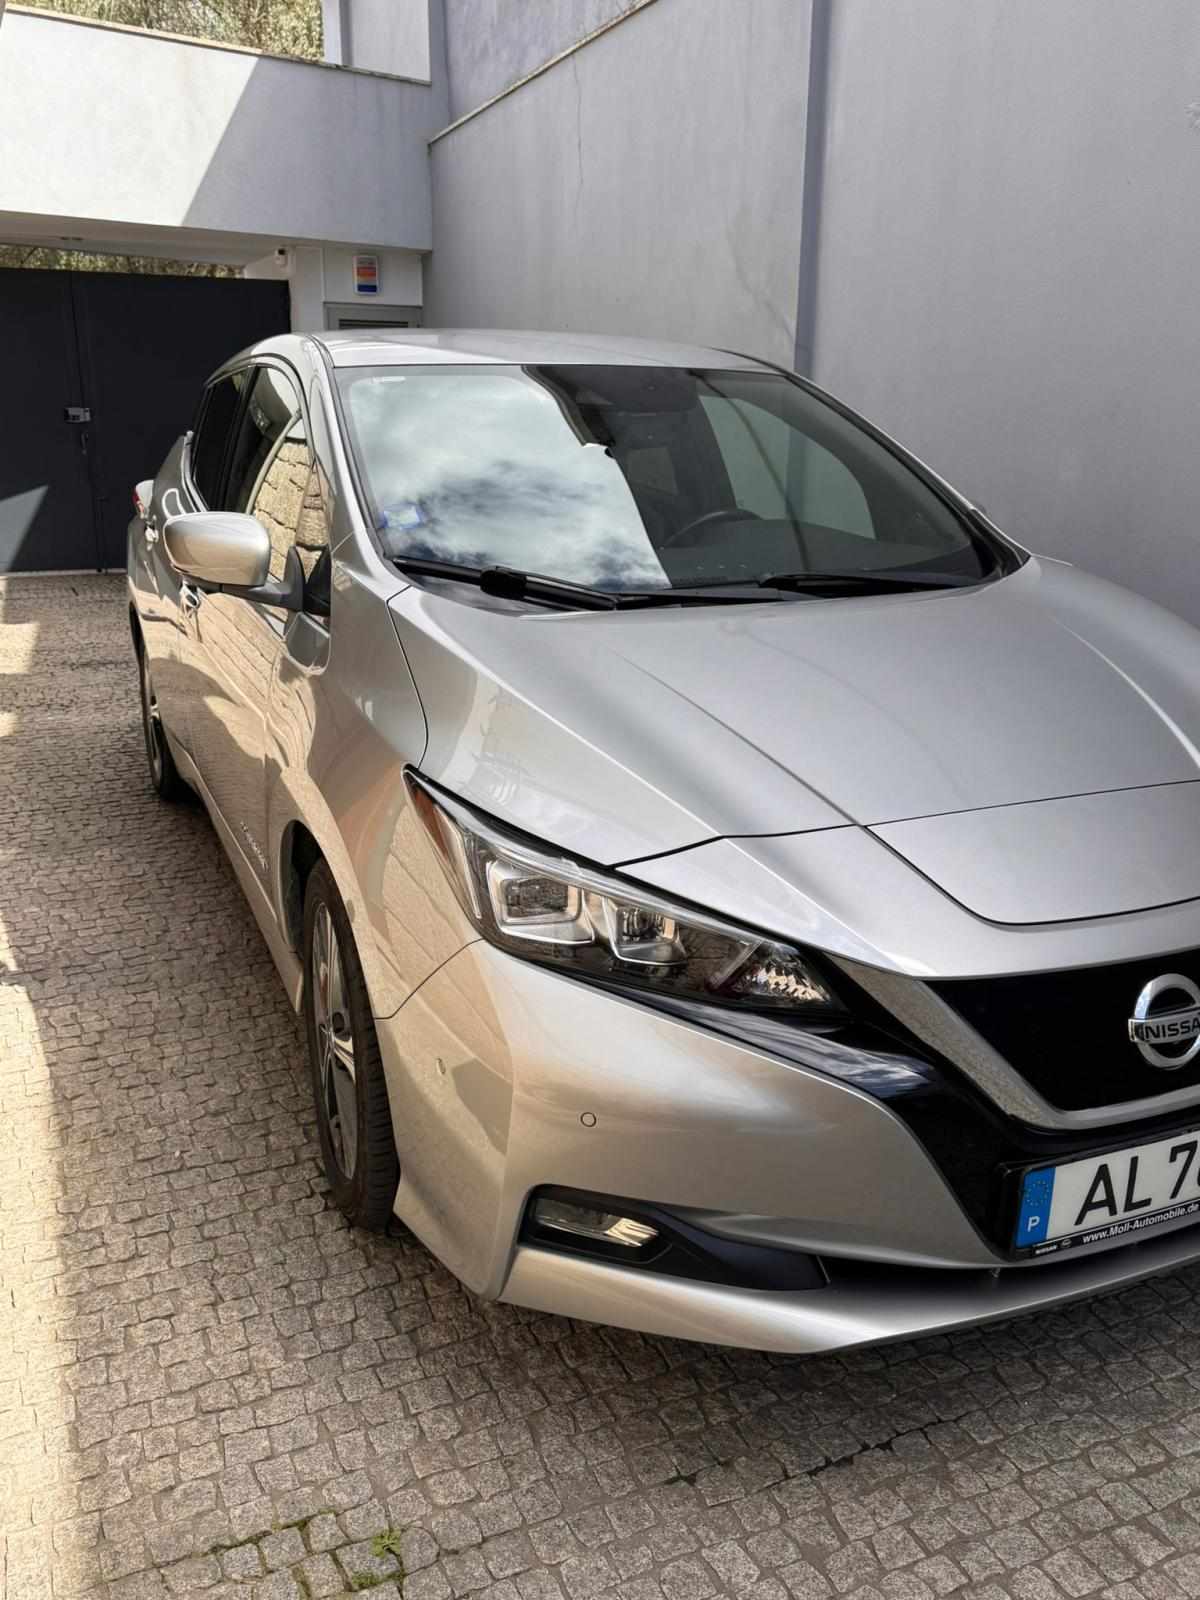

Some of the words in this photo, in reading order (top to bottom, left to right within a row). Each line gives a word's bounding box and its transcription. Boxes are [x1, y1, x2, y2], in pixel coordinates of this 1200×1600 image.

[1074, 1155, 1153, 1226] AL
[1168, 1140, 1200, 1200] 7
[1027, 1215, 1040, 1233] P
[1082, 1203, 1200, 1243] www.Moll-Automobile.de
